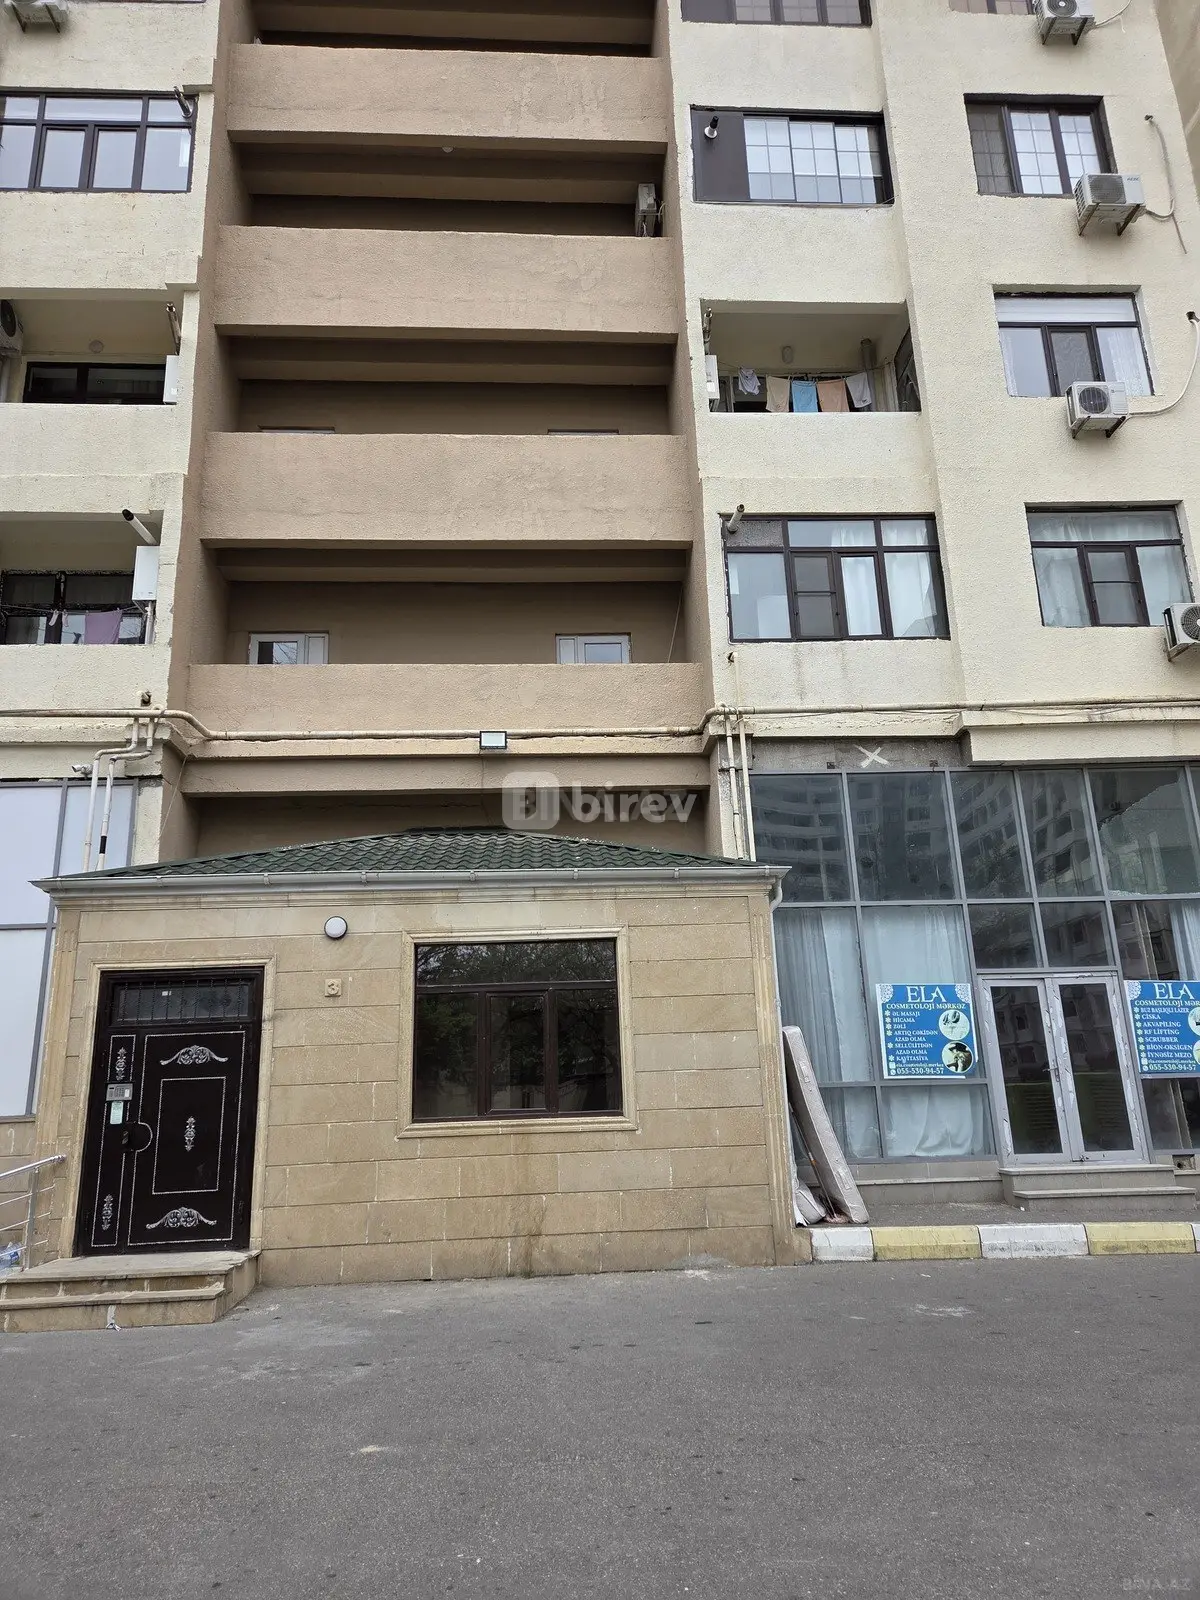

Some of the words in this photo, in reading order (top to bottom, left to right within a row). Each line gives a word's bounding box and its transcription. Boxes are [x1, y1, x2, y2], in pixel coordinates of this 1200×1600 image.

[906, 985, 947, 1003] ELA
[1153, 983, 1195, 1000] ELA
[896, 1067, 945, 1075] 055-530-94-57
